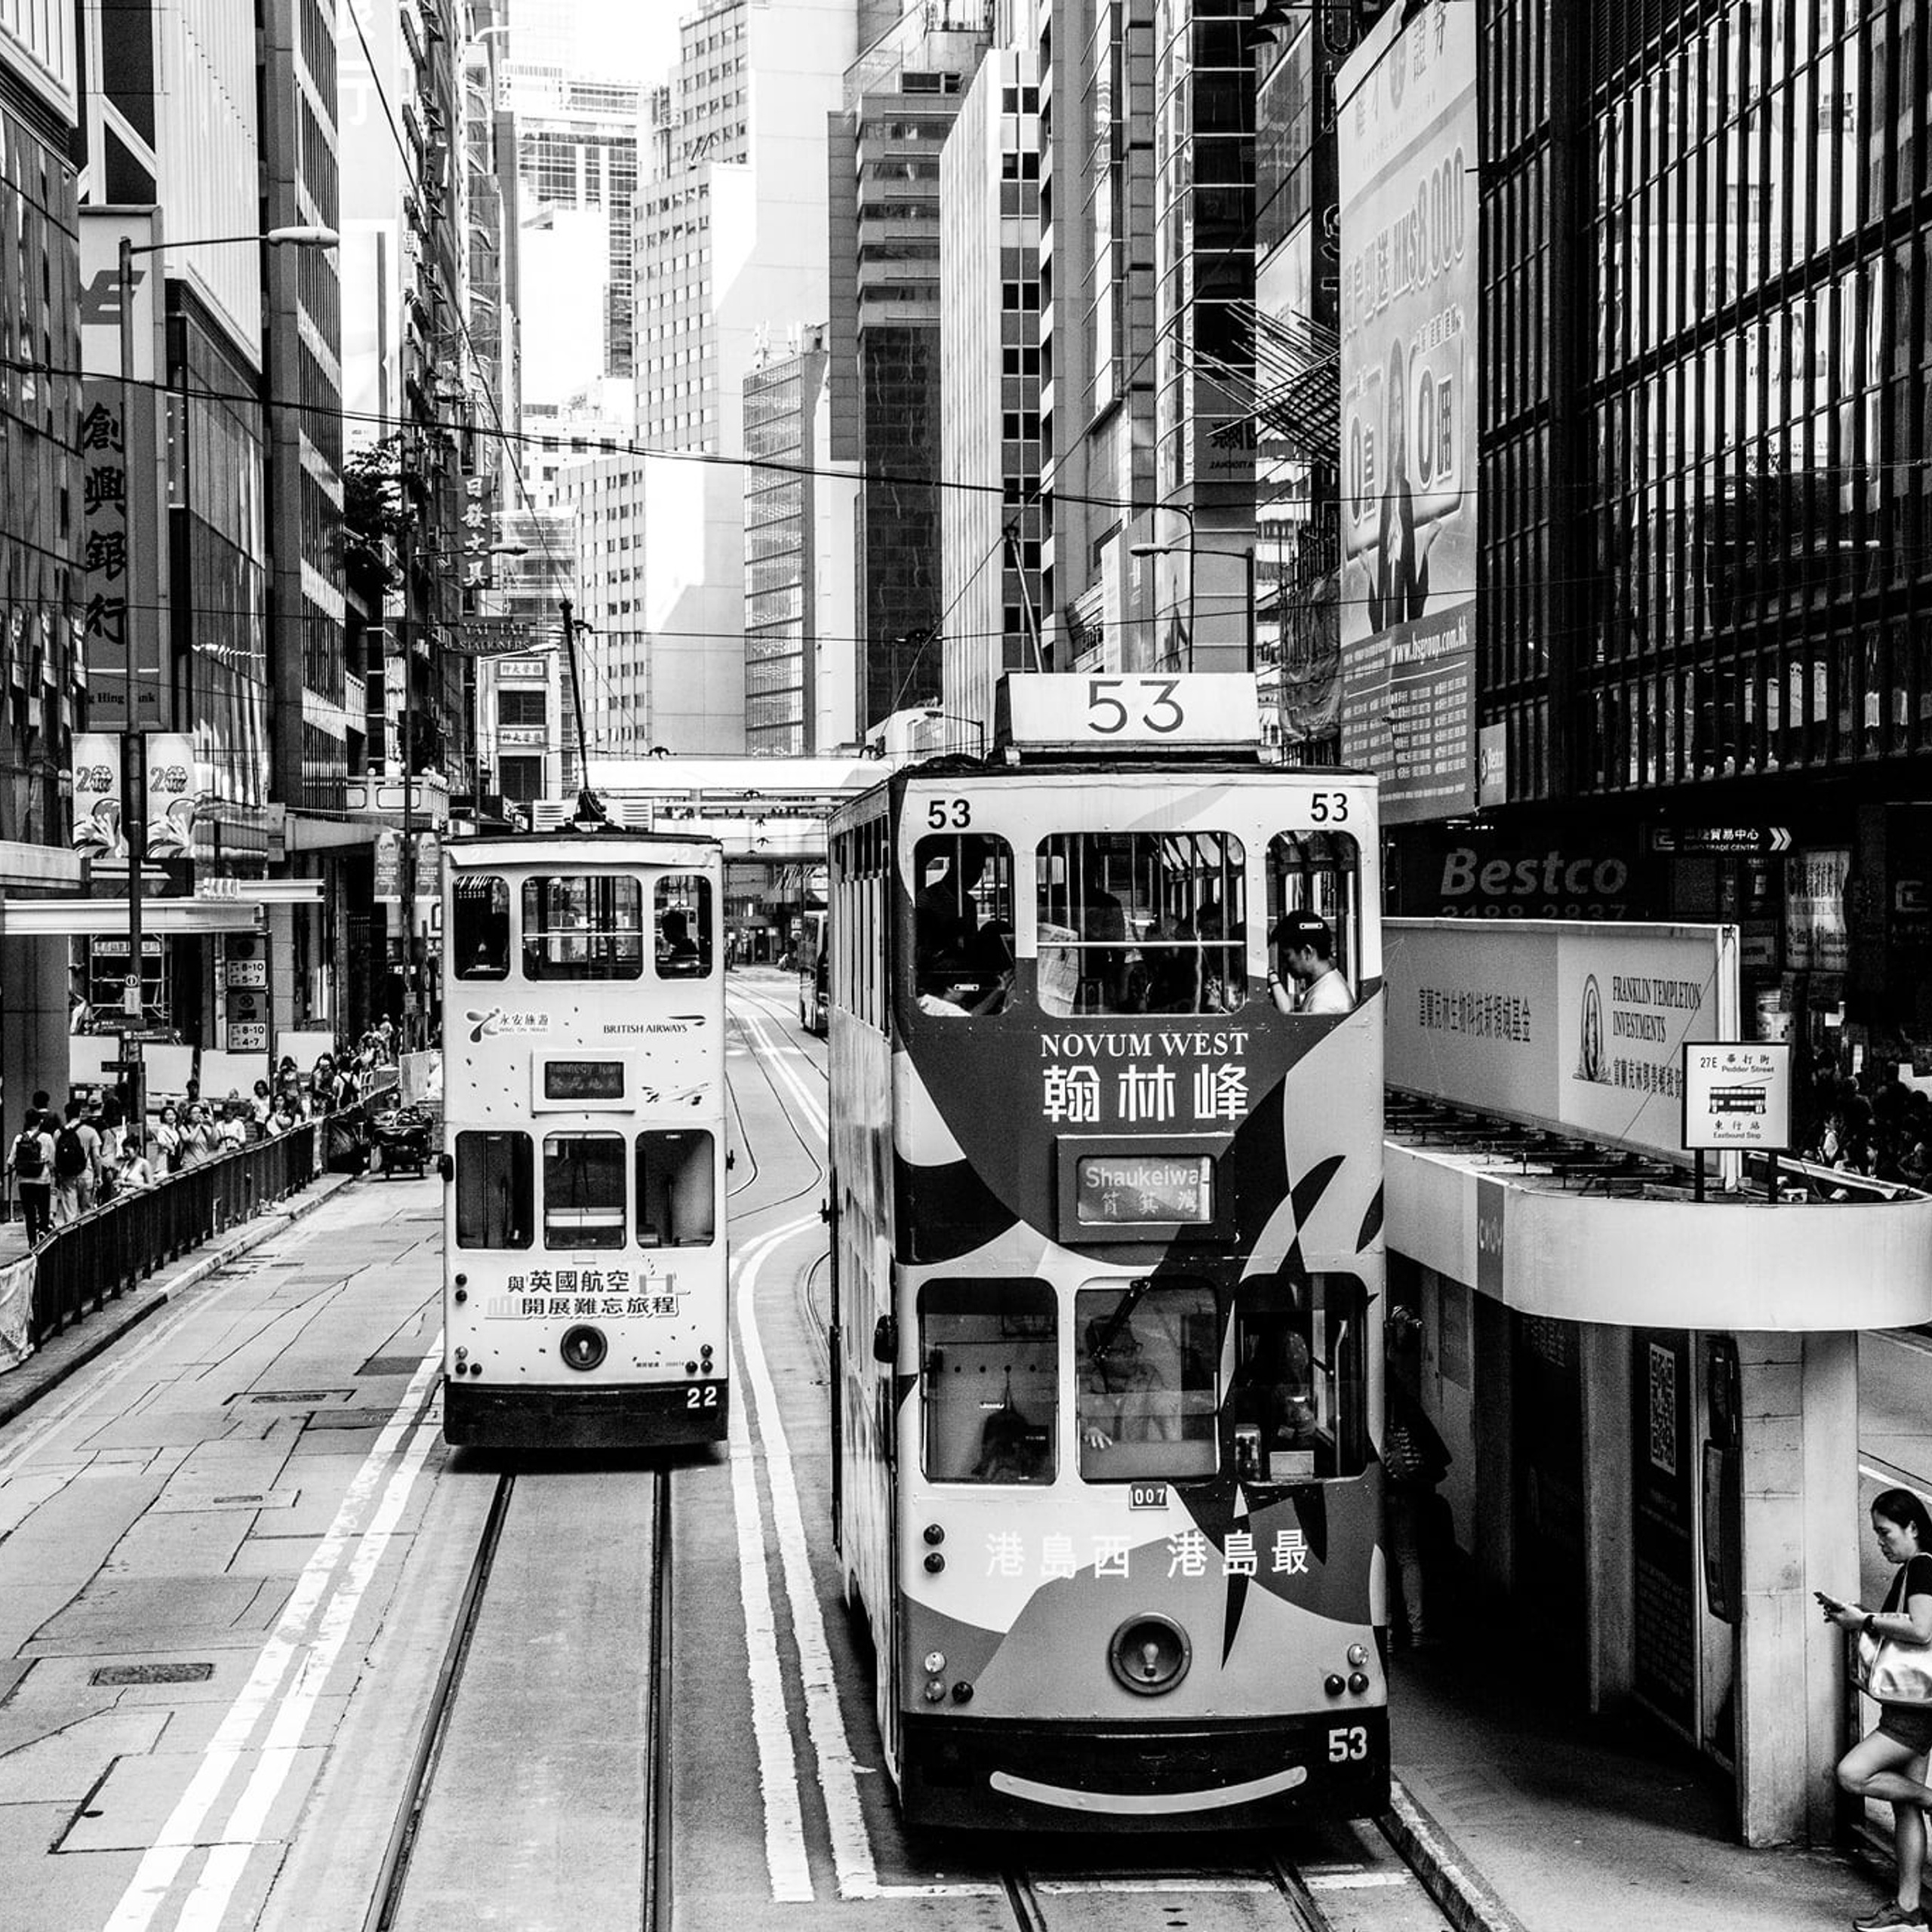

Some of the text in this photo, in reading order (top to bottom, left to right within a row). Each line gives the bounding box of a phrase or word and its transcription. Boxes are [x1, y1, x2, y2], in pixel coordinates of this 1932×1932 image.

[460, 478, 489, 586] 日發文具
[97, 692, 125, 704] Hing
[1088, 679, 1184, 734] 53
[927, 798, 971, 829] 53
[1310, 792, 1349, 823] 53
[1440, 848, 1628, 896] Bestco
[1613, 976, 1702, 1011] FRANKLIN TEMPLETON
[242, 1025, 264, 1035] 8-10
[604, 1023, 688, 1035] BRITISH AIRWAYS
[1613, 1011, 1667, 1043] INVESTMENTS
[1040, 1032, 1248, 1057] NOVUM WEST
[1700, 1057, 1718, 1068] 27E
[1042, 1063, 1249, 1123] 翰林峰
[507, 1270, 629, 1294] 與英國航空
[521, 1297, 676, 1315] 開展難忘旅程
[687, 1386, 717, 1408] 22
[1134, 1488, 1166, 1505] 007
[985, 1528, 1310, 1580] 港島西 港島最
[1328, 1726, 1368, 1763] 53
